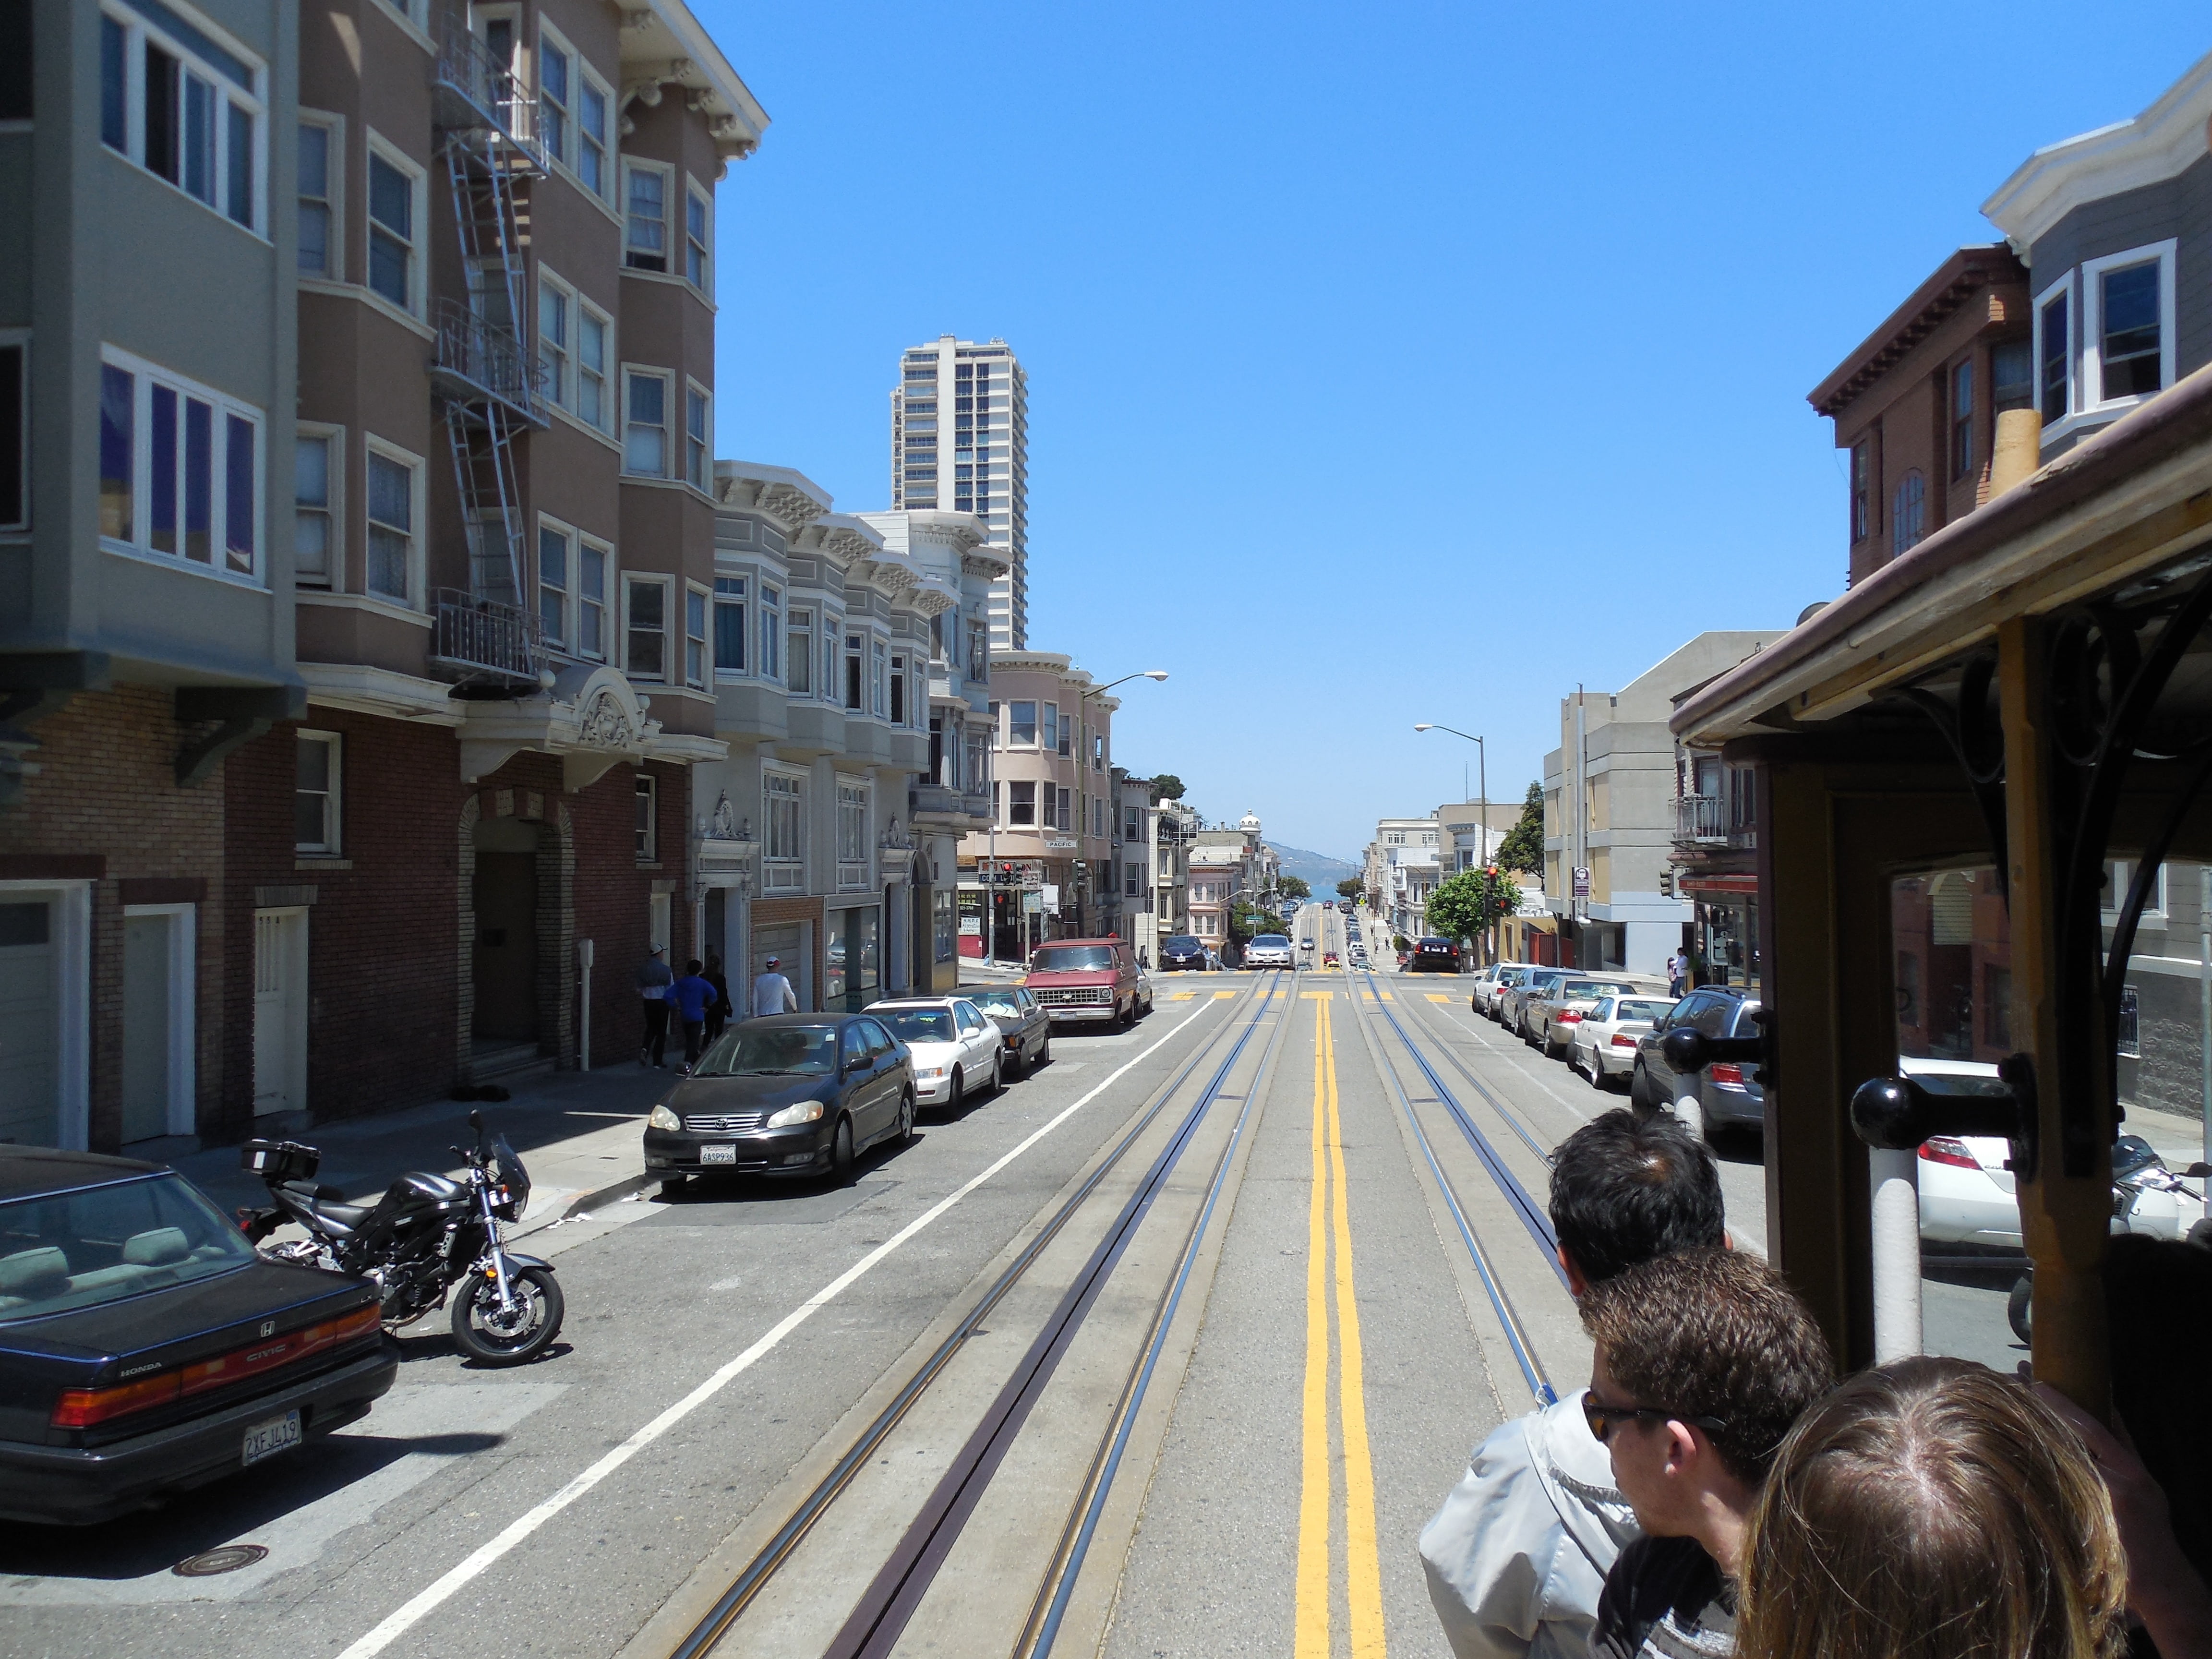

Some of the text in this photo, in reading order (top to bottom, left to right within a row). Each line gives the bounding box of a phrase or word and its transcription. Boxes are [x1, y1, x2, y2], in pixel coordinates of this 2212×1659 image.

[703, 1153, 733, 1161] 6ASP936
[246, 1344, 286, 1362] CIVIC
[120, 1361, 162, 1377] HONDA
[245, 1421, 296, 1456] 2XFJ419
